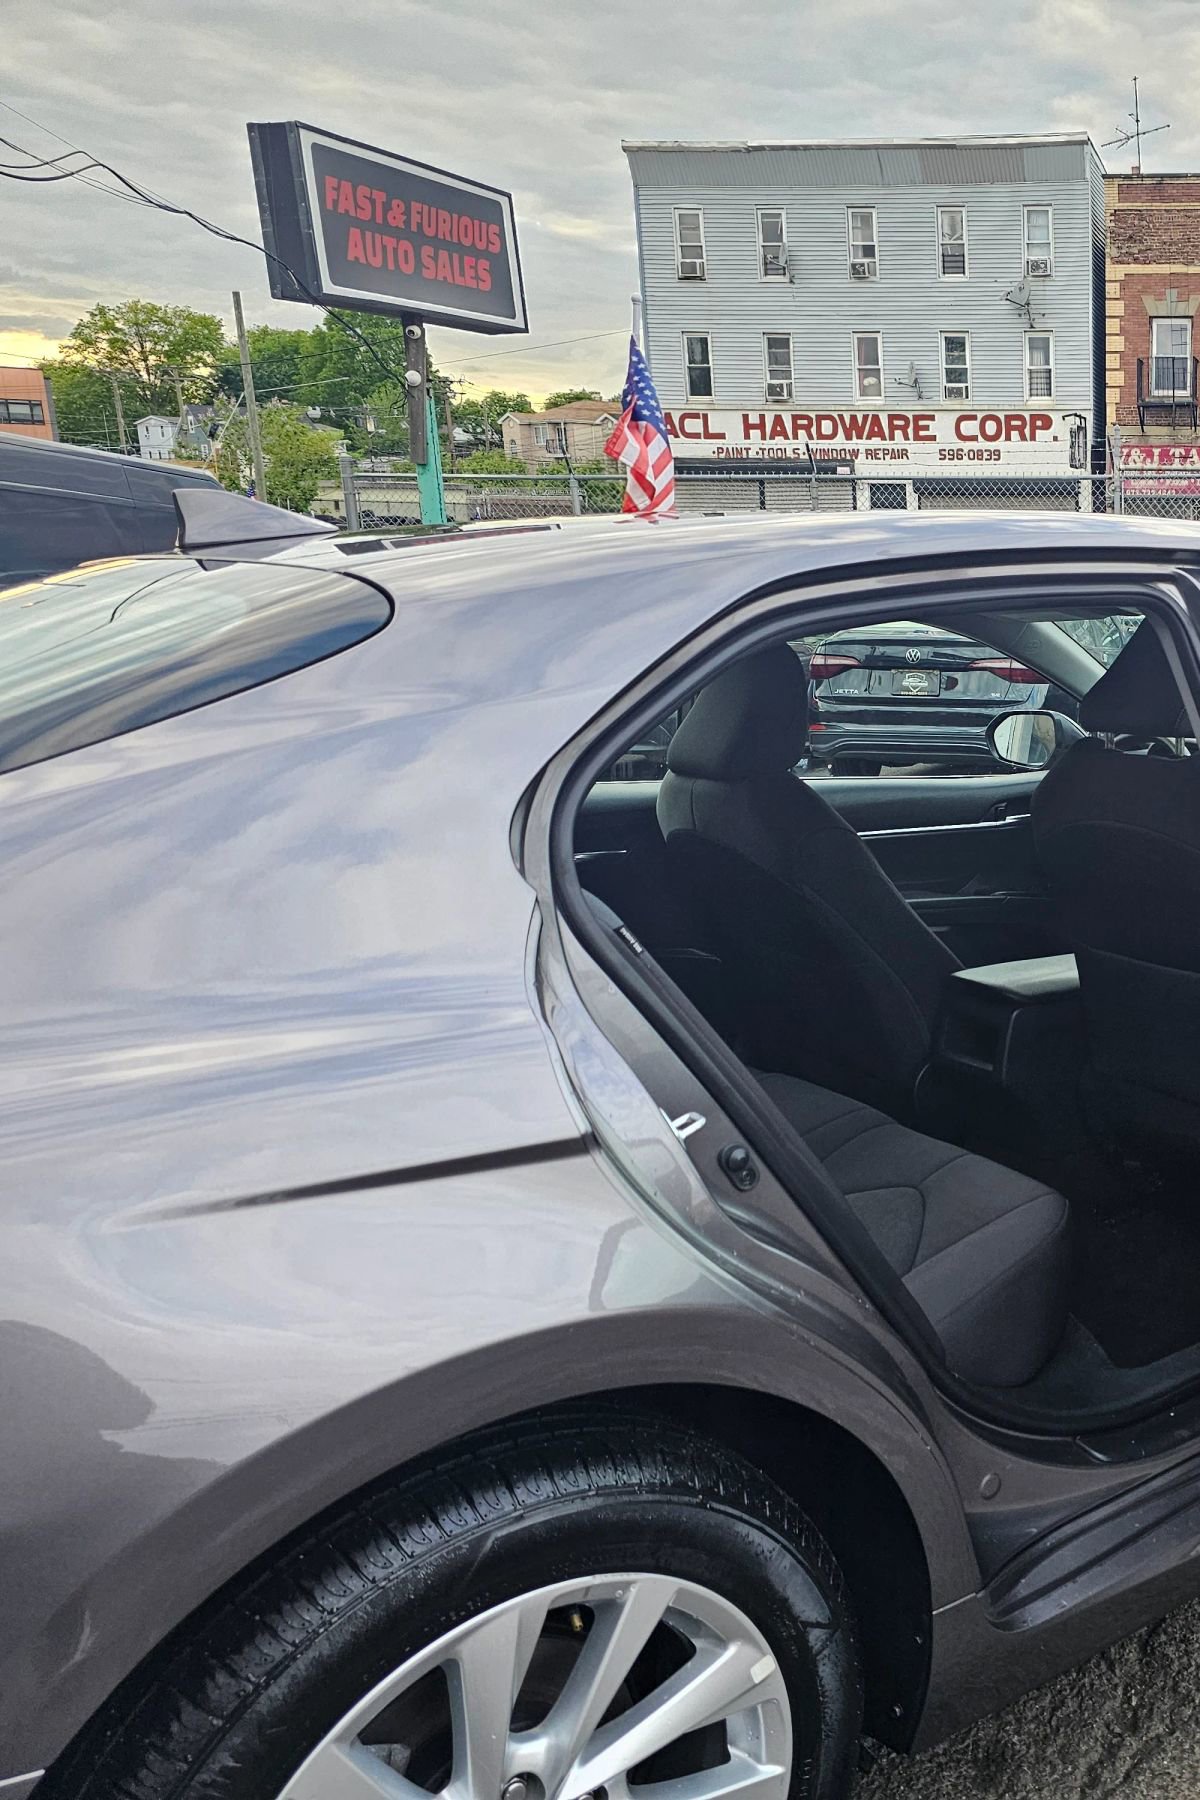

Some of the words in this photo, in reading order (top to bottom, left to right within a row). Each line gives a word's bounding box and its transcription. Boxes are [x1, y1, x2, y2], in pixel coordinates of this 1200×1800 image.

[324, 175, 386, 223] FAST
[387, 198, 407, 230] &
[411, 201, 501, 254] FURIOUS
[347, 228, 415, 274] AUTO
[421, 246, 492, 291] SALES
[664, 411, 727, 440] ACL
[742, 413, 937, 442] HARDWARE
[954, 413, 1059, 442] CORP.
[716, 446, 752, 459] PAINT
[759, 447, 801, 460] TOOLS
[864, 448, 910, 460] REPAIR
